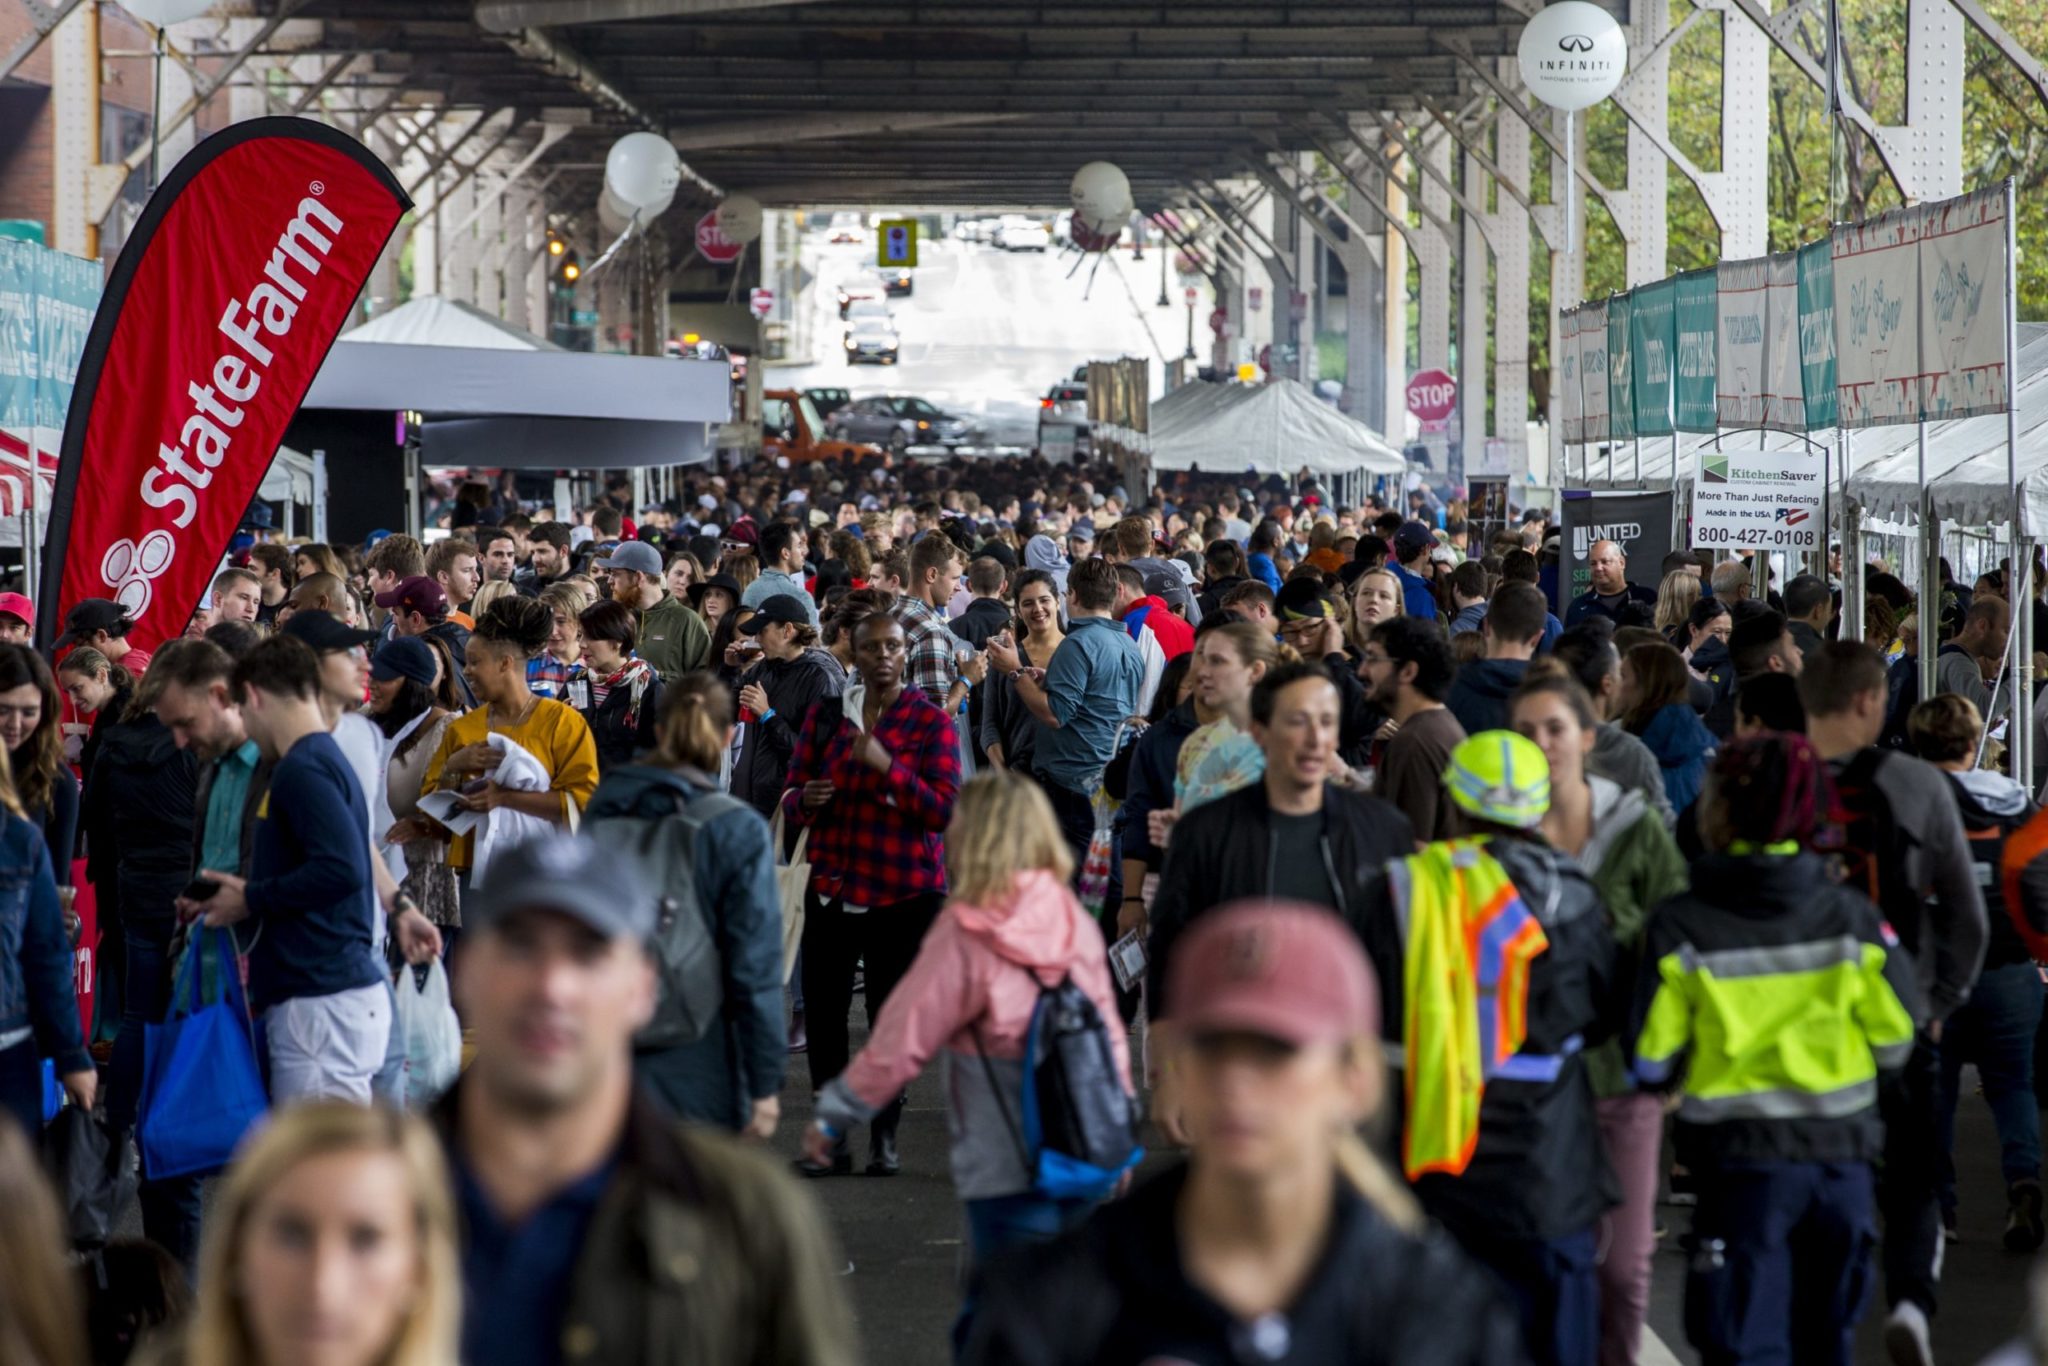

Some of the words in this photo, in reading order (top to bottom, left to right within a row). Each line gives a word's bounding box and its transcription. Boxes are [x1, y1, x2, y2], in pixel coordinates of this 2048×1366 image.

[1540, 60, 1610, 70] INFINITI
[700, 225, 732, 245] STO
[1408, 383, 1455, 410] STOP
[1731, 468, 1817, 481] KitchenSaver
[1697, 491, 1721, 500] More
[1725, 492, 1749, 501] Than
[1752, 494, 1773, 502] Just
[1776, 495, 1819, 506] Refacing
[1729, 509, 1737, 517] in
[1740, 509, 1753, 517] the
[1587, 523, 1642, 541] UNITED
[1698, 527, 1814, 545] 800-427-0108
